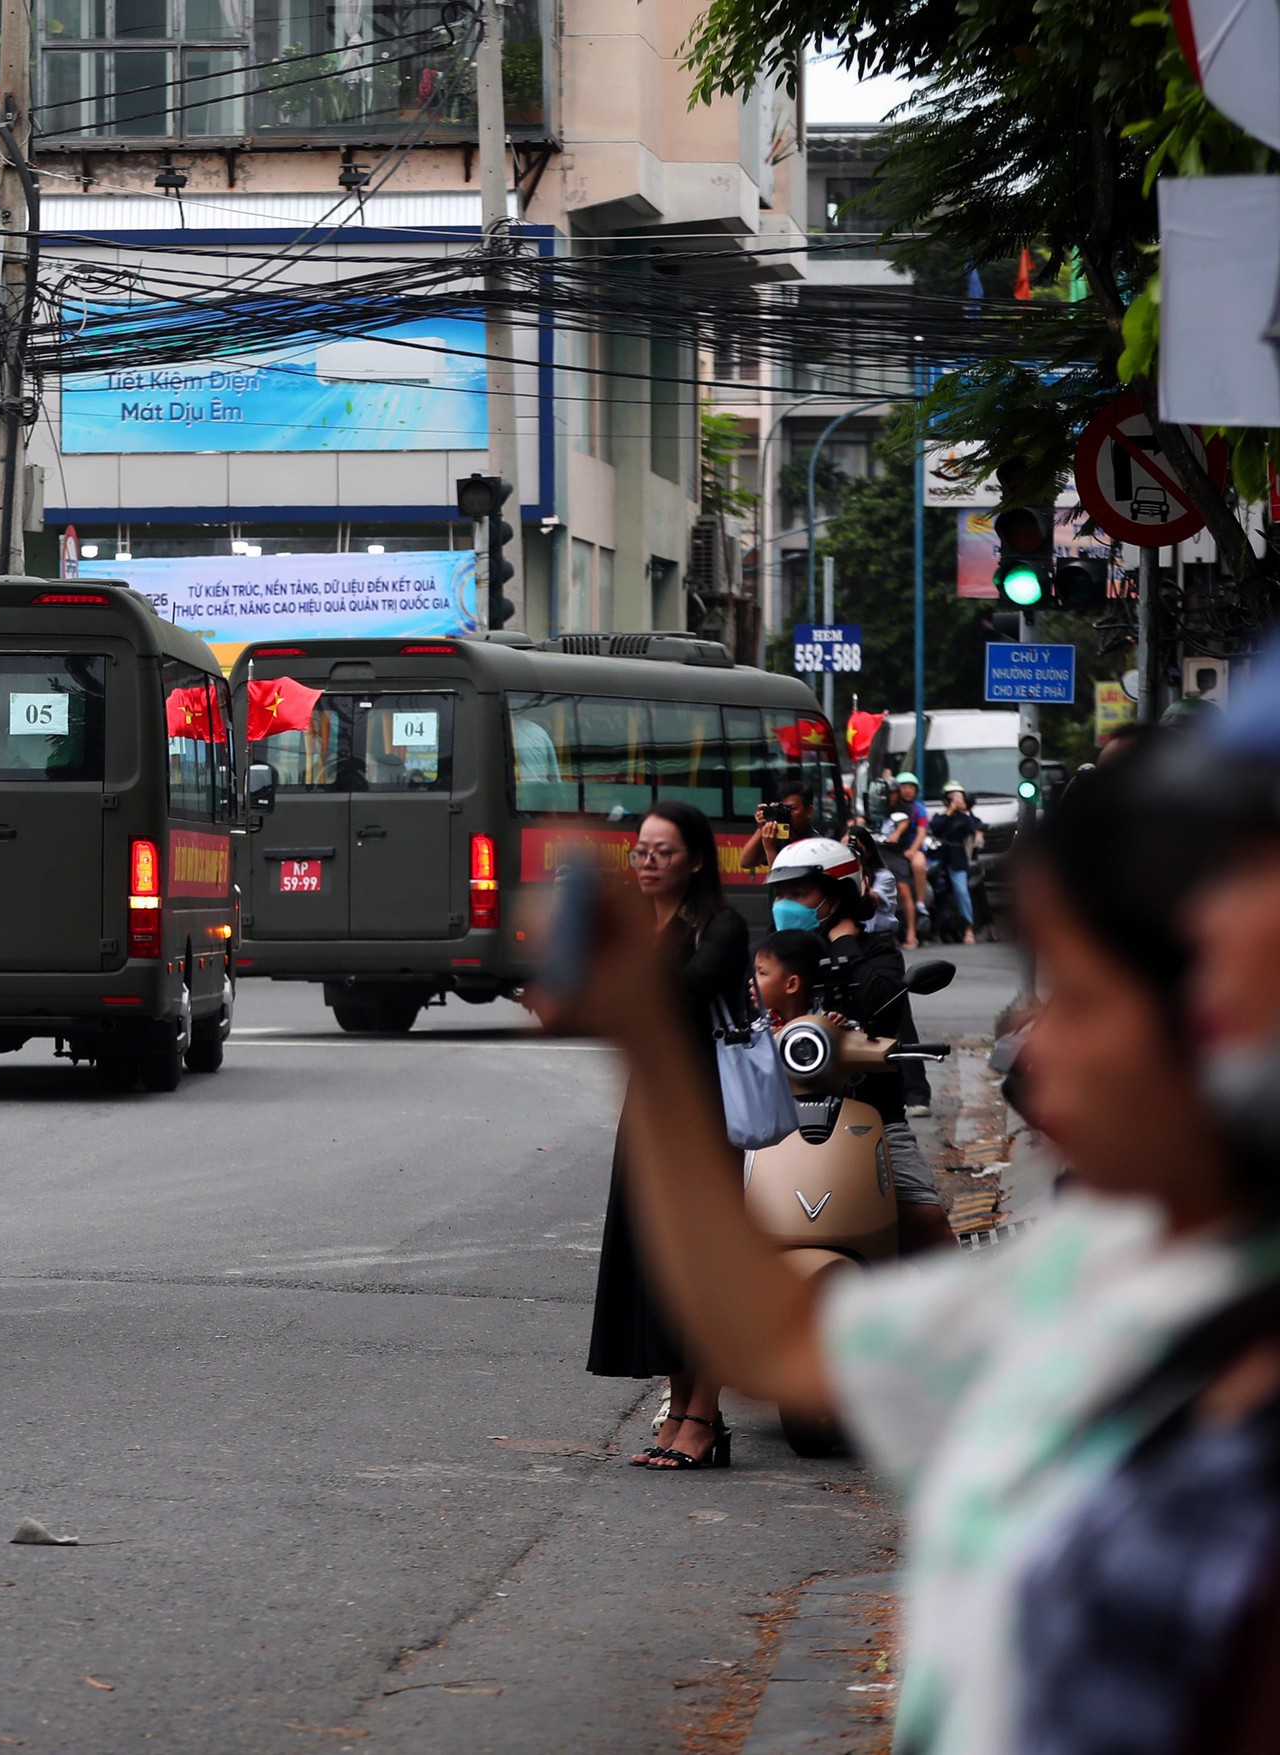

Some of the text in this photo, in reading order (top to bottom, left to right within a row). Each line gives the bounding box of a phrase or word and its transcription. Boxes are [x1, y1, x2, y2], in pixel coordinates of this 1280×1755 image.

[106, 370, 261, 396] Tiết Kiệm Điện
[121, 397, 244, 427] Mát Dịu Êm
[188, 582, 203, 599] TỪ
[205, 579, 229, 598] KIẾN
[232, 581, 263, 598] TRÚC,
[290, 578, 321, 596] TẢNG,
[324, 578, 341, 594] DỮ
[342, 578, 365, 597] LIỆU
[367, 576, 389, 593] ĐẾN
[391, 575, 411, 592] KẾT
[413, 575, 436, 592] QUẢ
[176, 593, 450, 620] THỰC CHẤT, NÂNG CAO HIỆU QUẢ QUẢN TRỊ QUỐC GIA
[794, 643, 861, 672] 552-588
[993, 685, 1012, 696] CHO
[1014, 685, 1028, 697] XE
[25, 704, 53, 724] 05
[404, 721, 425, 737] 04
[293, 861, 308, 876] KP
[283, 876, 318, 891] 59-99
